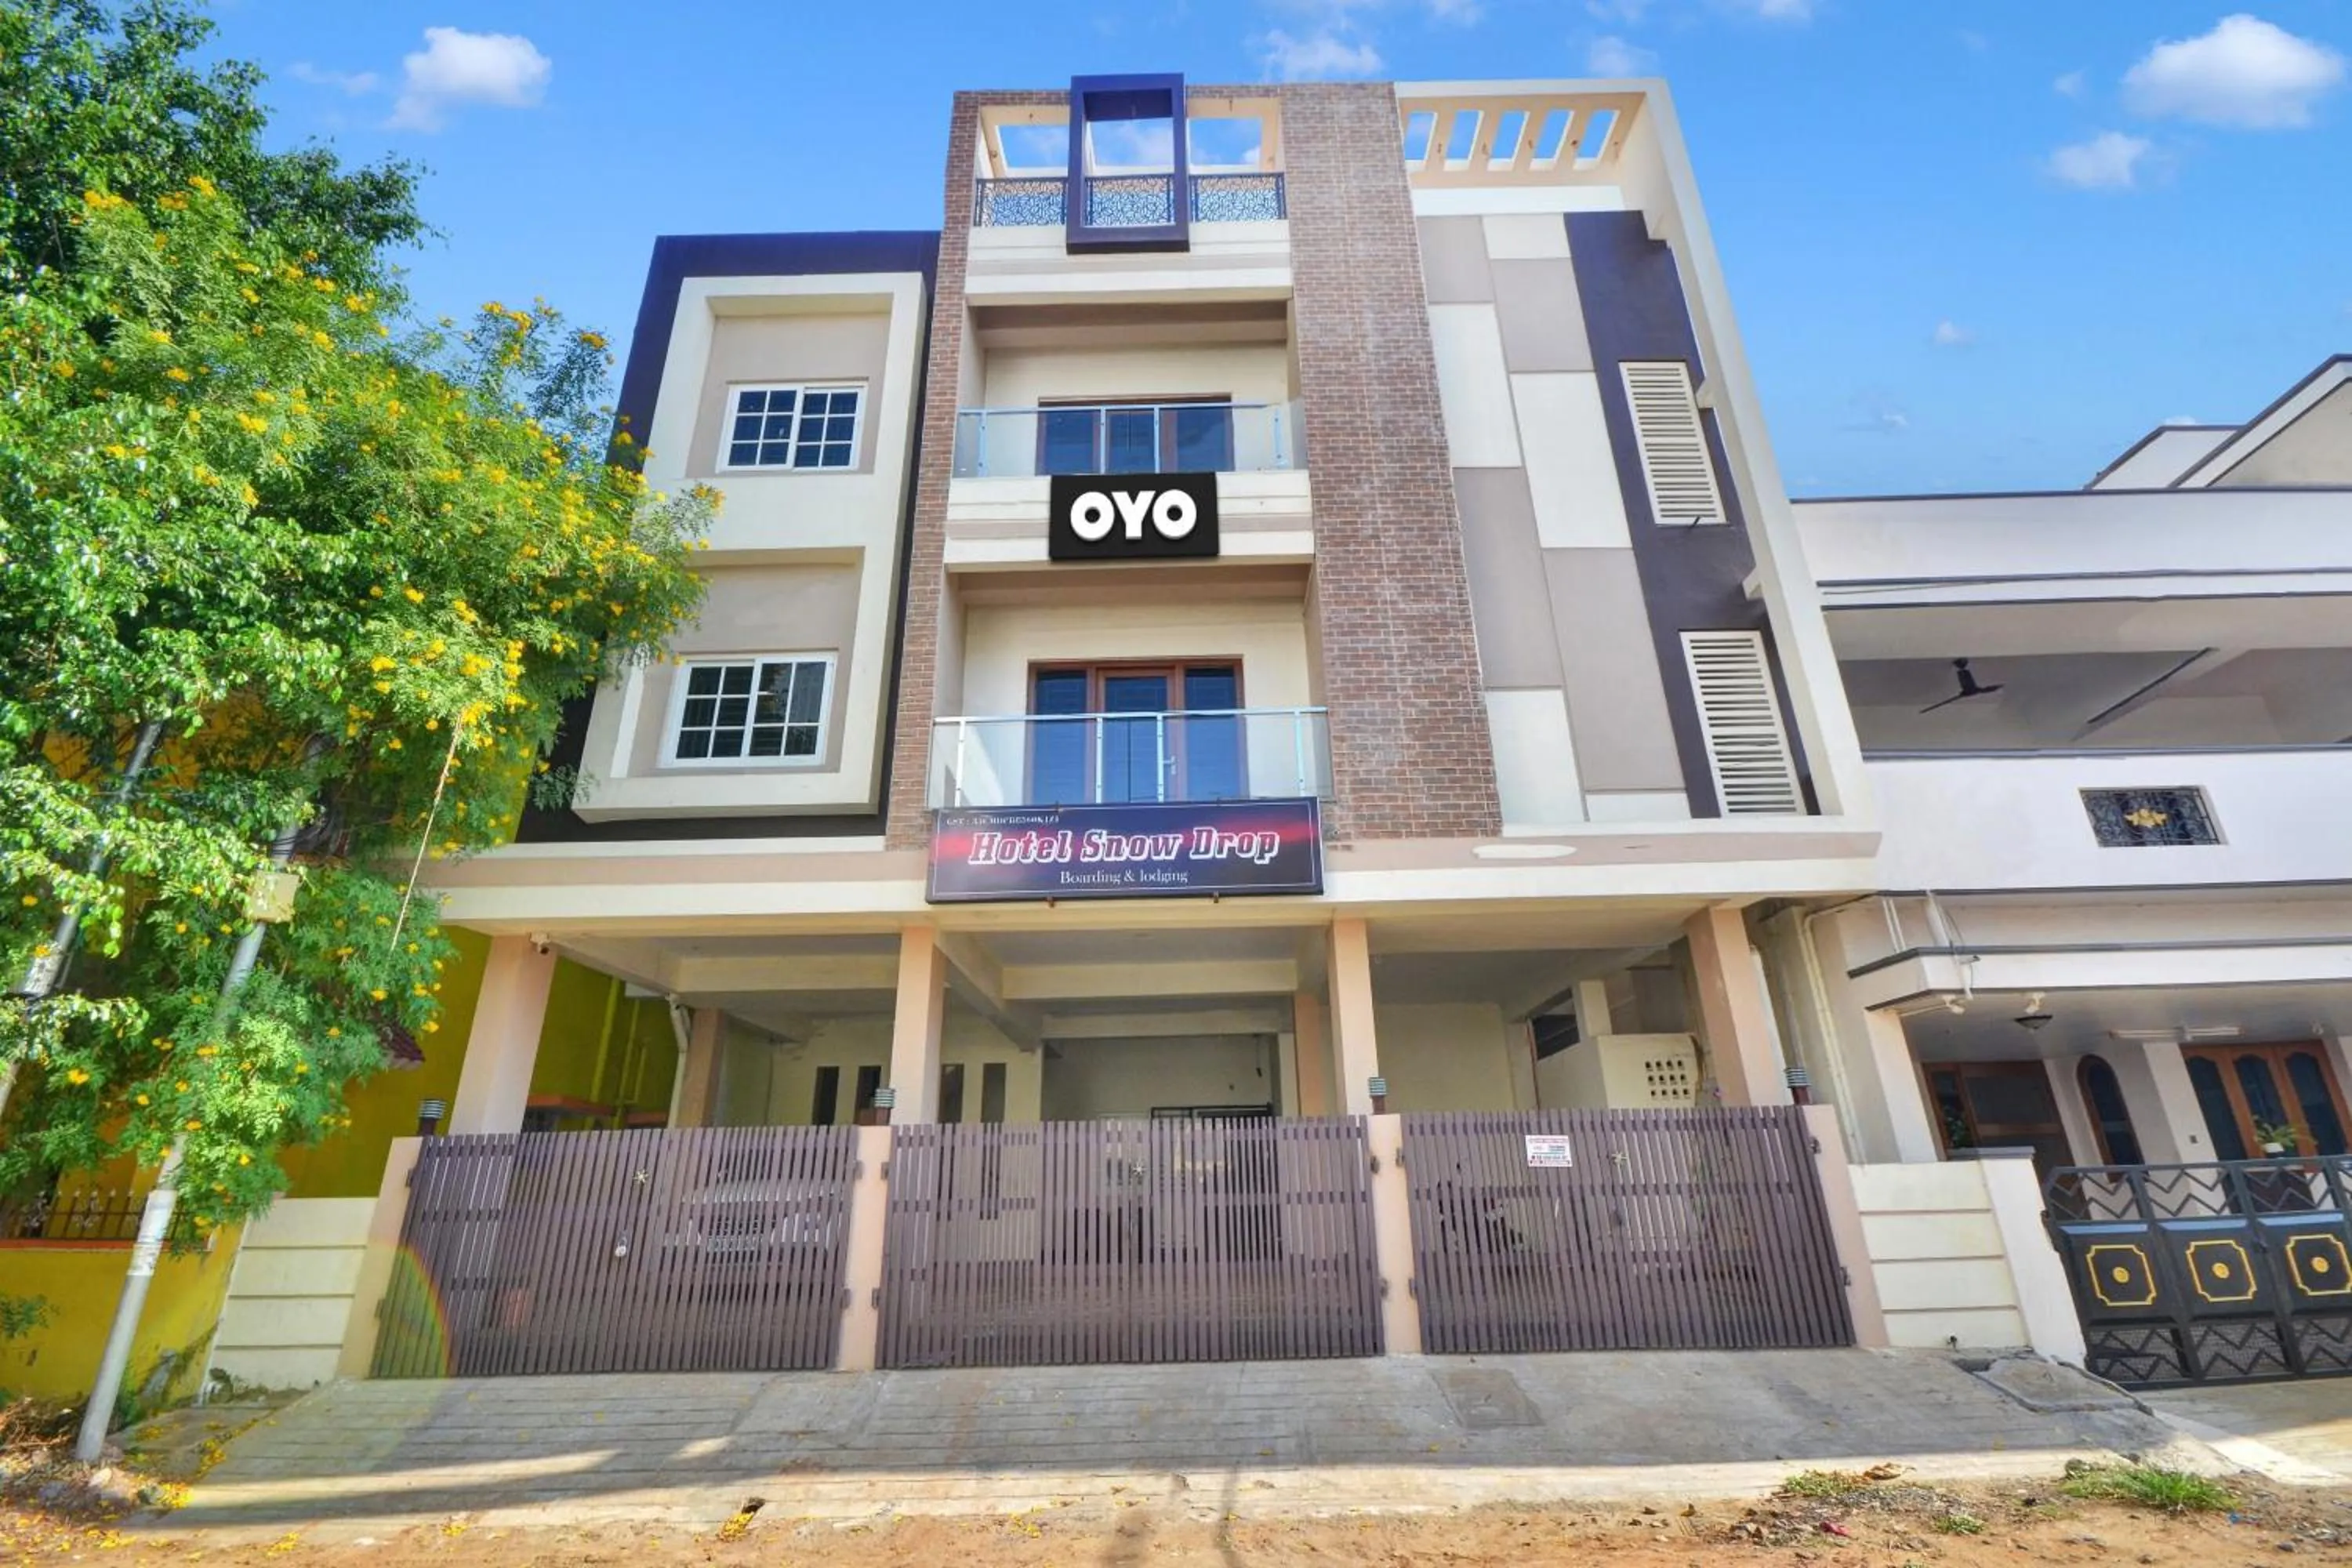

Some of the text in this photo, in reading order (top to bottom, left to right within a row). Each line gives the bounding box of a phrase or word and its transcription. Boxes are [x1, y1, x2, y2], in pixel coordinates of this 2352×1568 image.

[1070, 489, 1196, 541] OYO
[969, 826, 1279, 864] Hotel Snow Drop
[1060, 869, 1189, 884] Boarding & lodging
